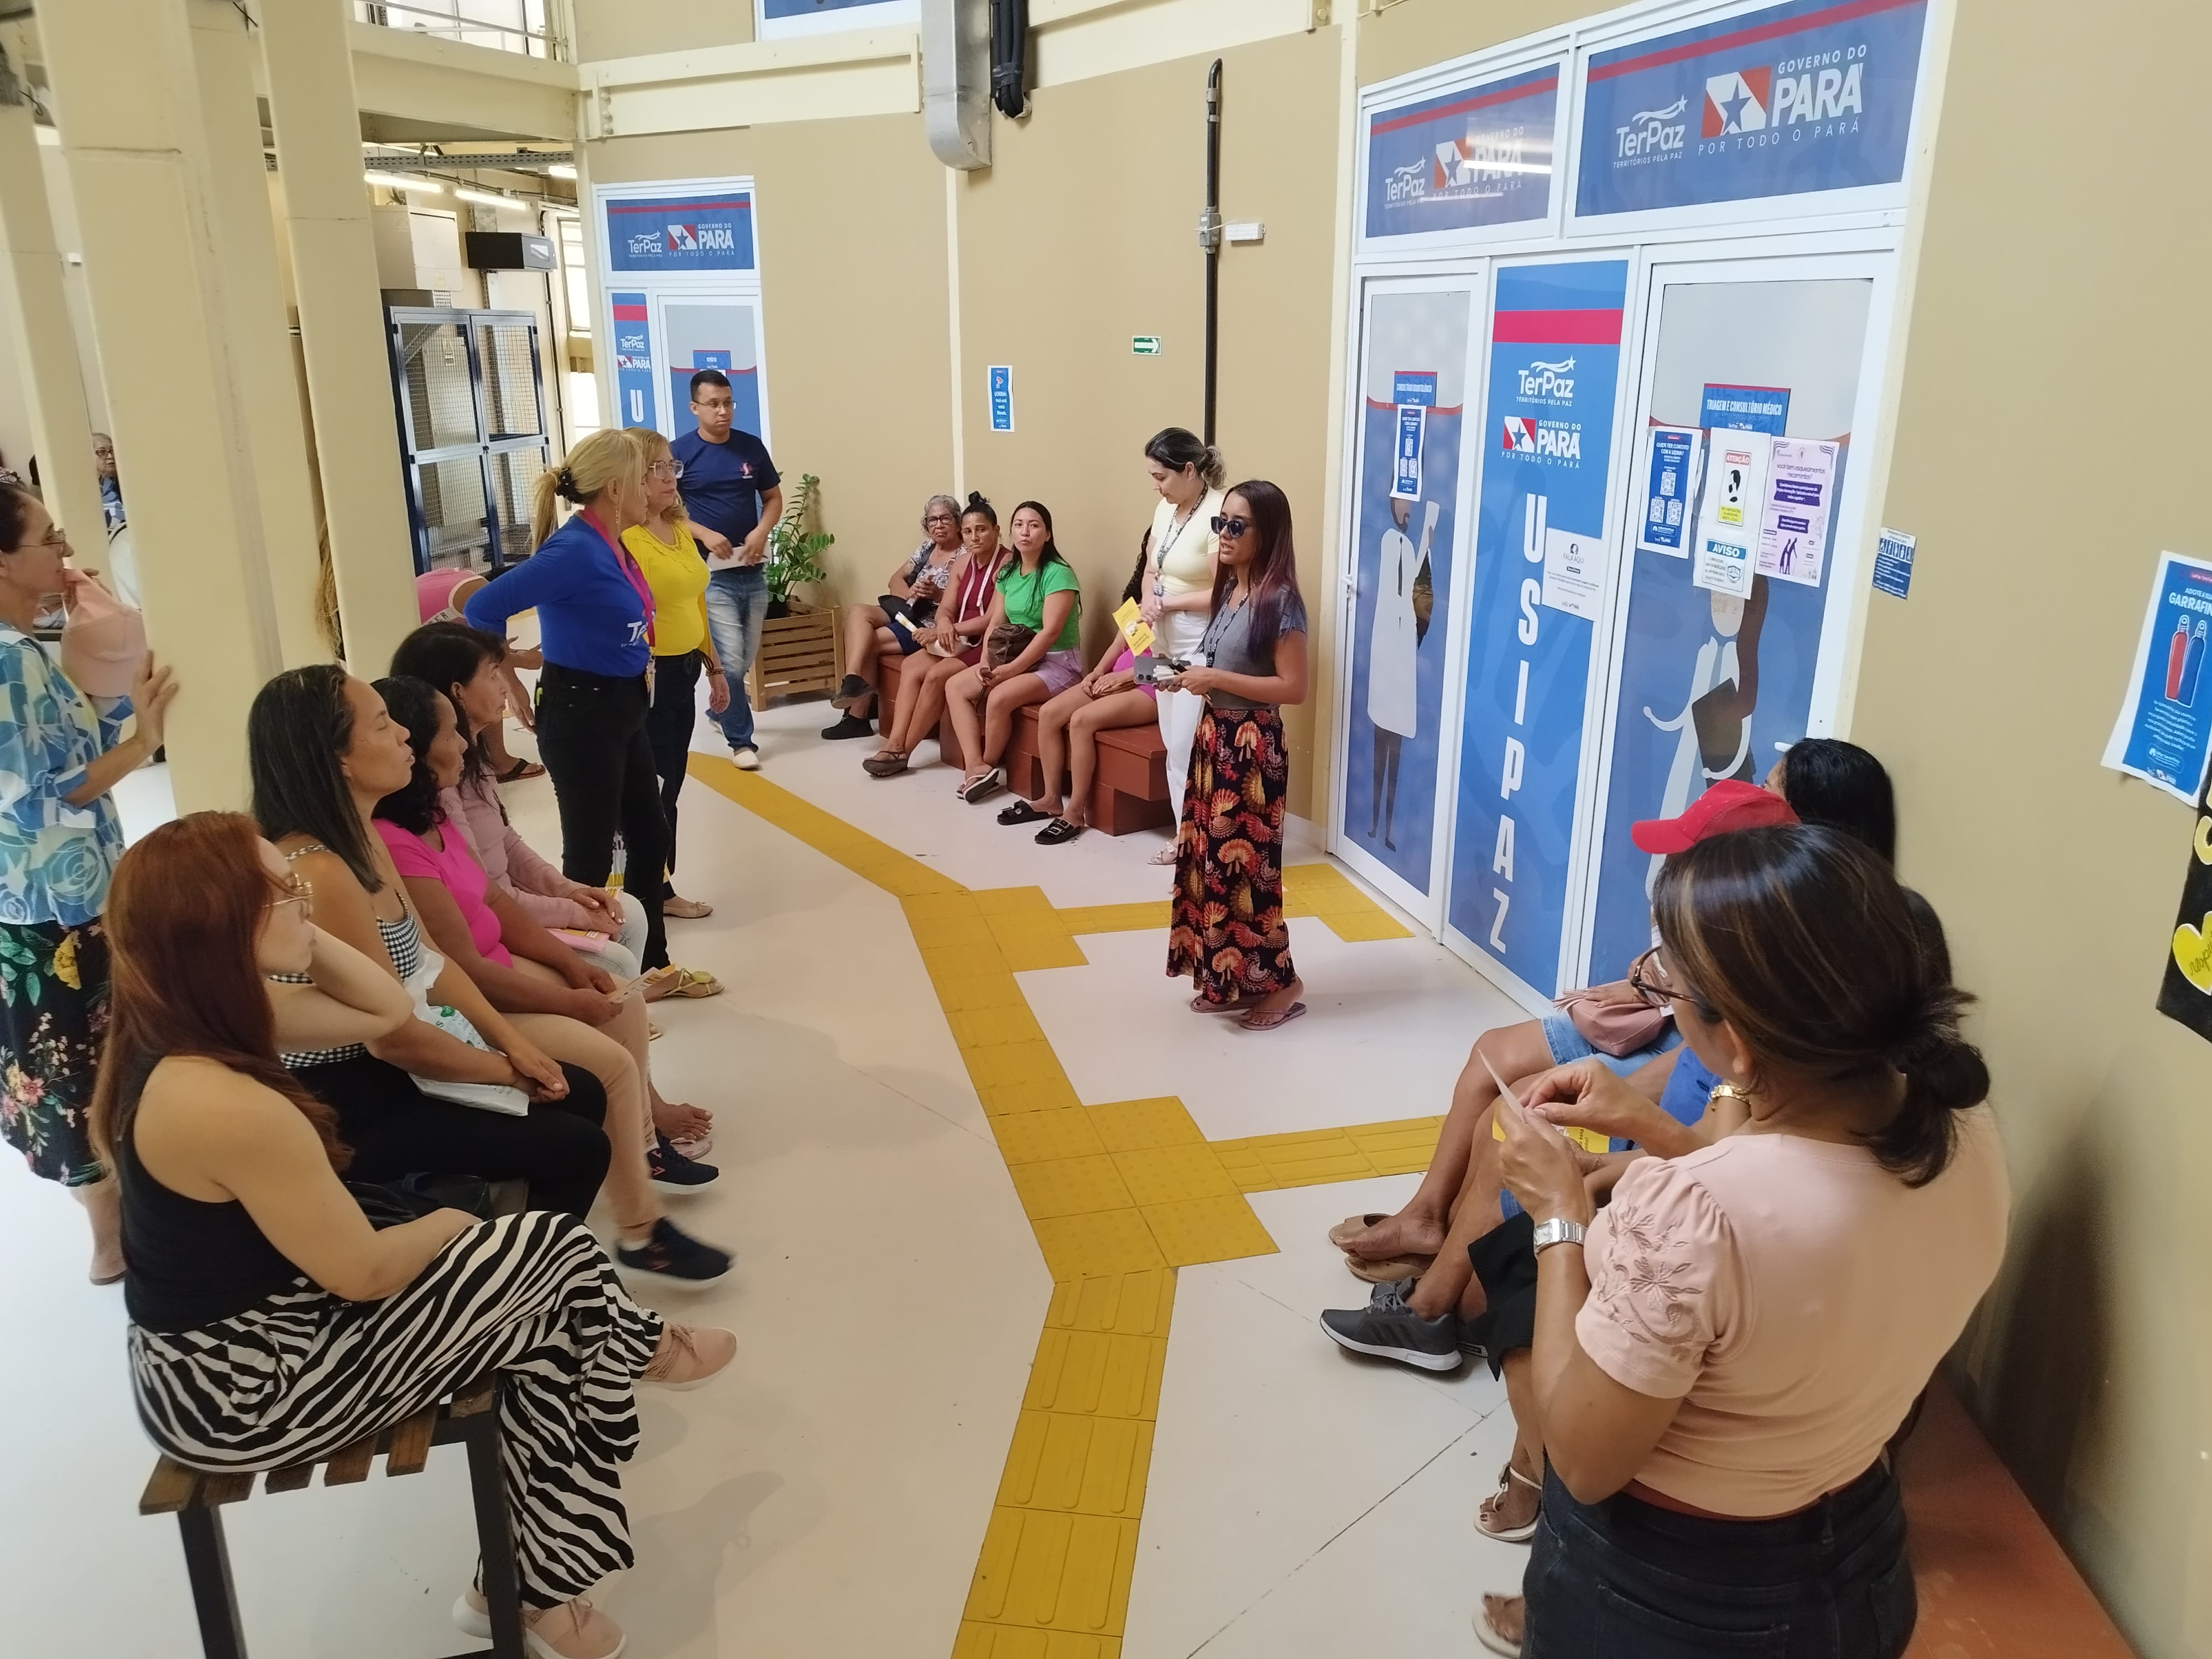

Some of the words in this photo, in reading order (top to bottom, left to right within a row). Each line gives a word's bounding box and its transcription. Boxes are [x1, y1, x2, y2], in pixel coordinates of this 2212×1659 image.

[1778, 50, 1840, 74] GOVERNO
[1848, 44, 1866, 61] DO
[1771, 62, 1863, 128] PARÁ
[1514, 126, 1524, 136] DO
[1616, 121, 1685, 157] TerPaz
[1698, 141, 1725, 155] POR
[1738, 135, 1779, 148] TODO
[1793, 129, 1801, 140] O
[1814, 117, 1859, 138] PARÁ
[1614, 155, 1651, 169] TERRITÓRIOS
[1652, 154, 1668, 164] PELA
[1670, 152, 1682, 160] PAZ
[1385, 175, 1425, 201] TerPaz
[1455, 186, 1479, 198] TODO
[1485, 185, 1490, 193] O
[628, 239, 662, 253] TerPaz
[698, 229, 734, 249] PARÁ
[620, 339, 644, 348] TerPaz
[1519, 370, 1574, 398] TerPaz
[1516, 397, 1546, 405] TERRITÓRIOS
[1707, 399, 1726, 411] TRIAGEM
[1727, 401, 1730, 411] E
[1730, 400, 1762, 414] CONSULTÓRIO
[1762, 401, 1782, 415] MÉDICO
[1539, 420, 1568, 429] GOVERNO
[1537, 429, 1580, 460] PARÁ
[1521, 453, 1541, 463] TODO
[1558, 460, 1579, 469] PARÁ
[1726, 455, 1749, 464] ATENÇÃO
[1712, 543, 1740, 557] AVISO
[2184, 587, 2201, 597] ADOTE
[1489, 493, 1547, 954] USIPAZ
